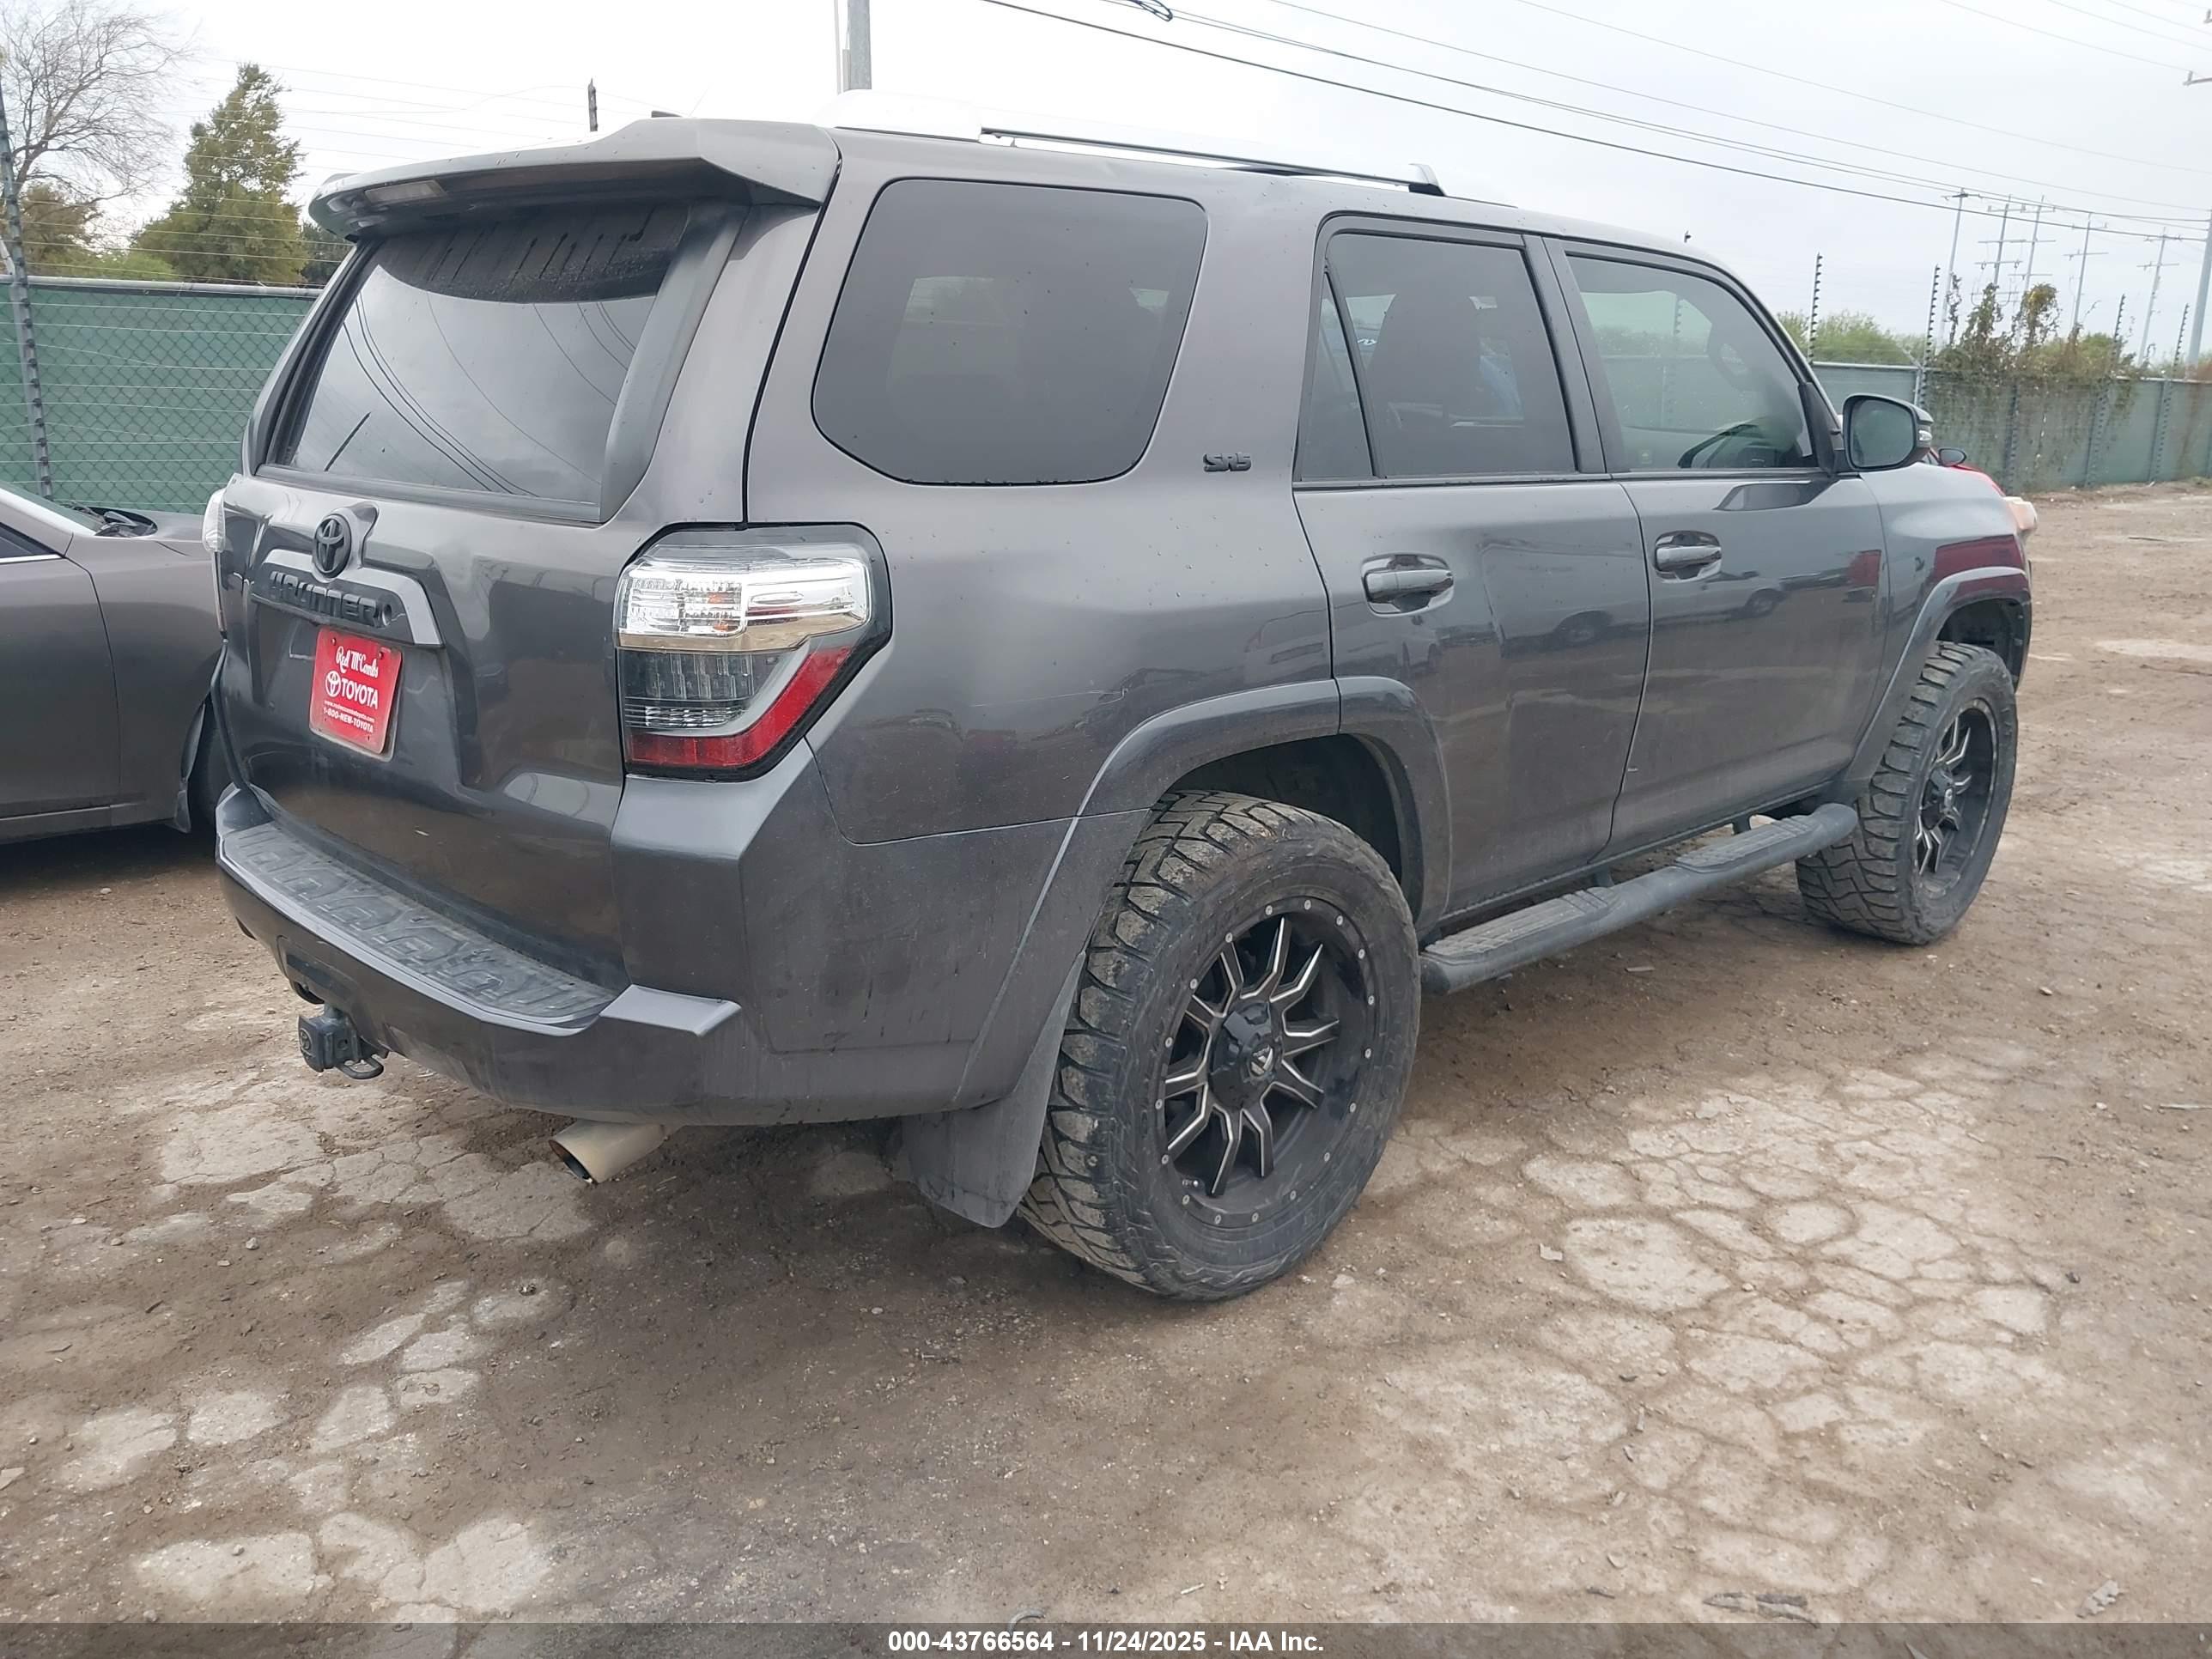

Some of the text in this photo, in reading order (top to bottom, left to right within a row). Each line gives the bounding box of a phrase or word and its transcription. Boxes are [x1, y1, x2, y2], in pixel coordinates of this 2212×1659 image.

[1202, 453, 1252, 472] SR5
[336, 646, 379, 678] Red McCombs
[342, 677, 379, 709] TOYOTA
[324, 707, 374, 733] 1-800-NEW-TOYOTA
